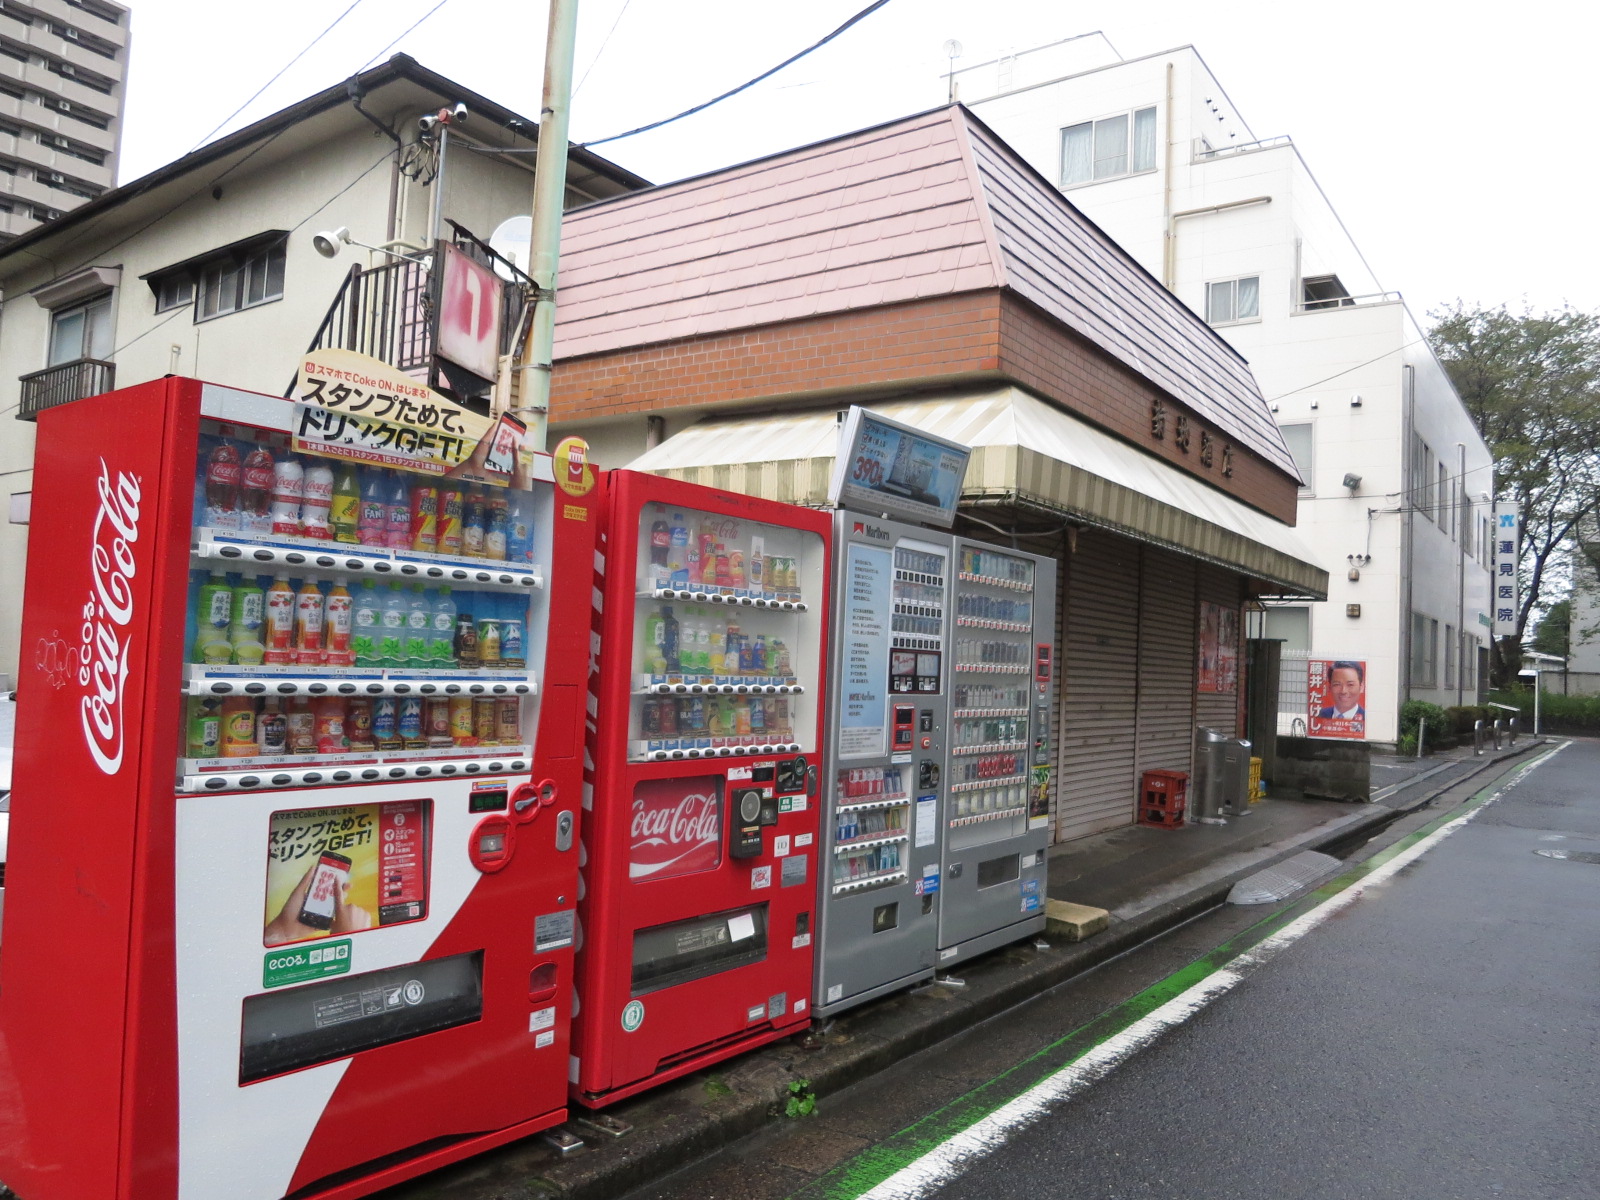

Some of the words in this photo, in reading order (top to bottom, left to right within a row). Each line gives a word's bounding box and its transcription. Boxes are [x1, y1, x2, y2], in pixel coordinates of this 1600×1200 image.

[300, 377, 466, 434] スタンプためて、
[364, 507, 386, 519] FANT
[391, 512, 411, 522] FANT
[866, 524, 890, 540] Marlboro
[1497, 540, 1514, 622] 蓮見医院
[81, 456, 142, 775] Coca-Cola
[1309, 661, 1323, 731] 藤井たけし
[630, 792, 718, 844] oca-Cola
